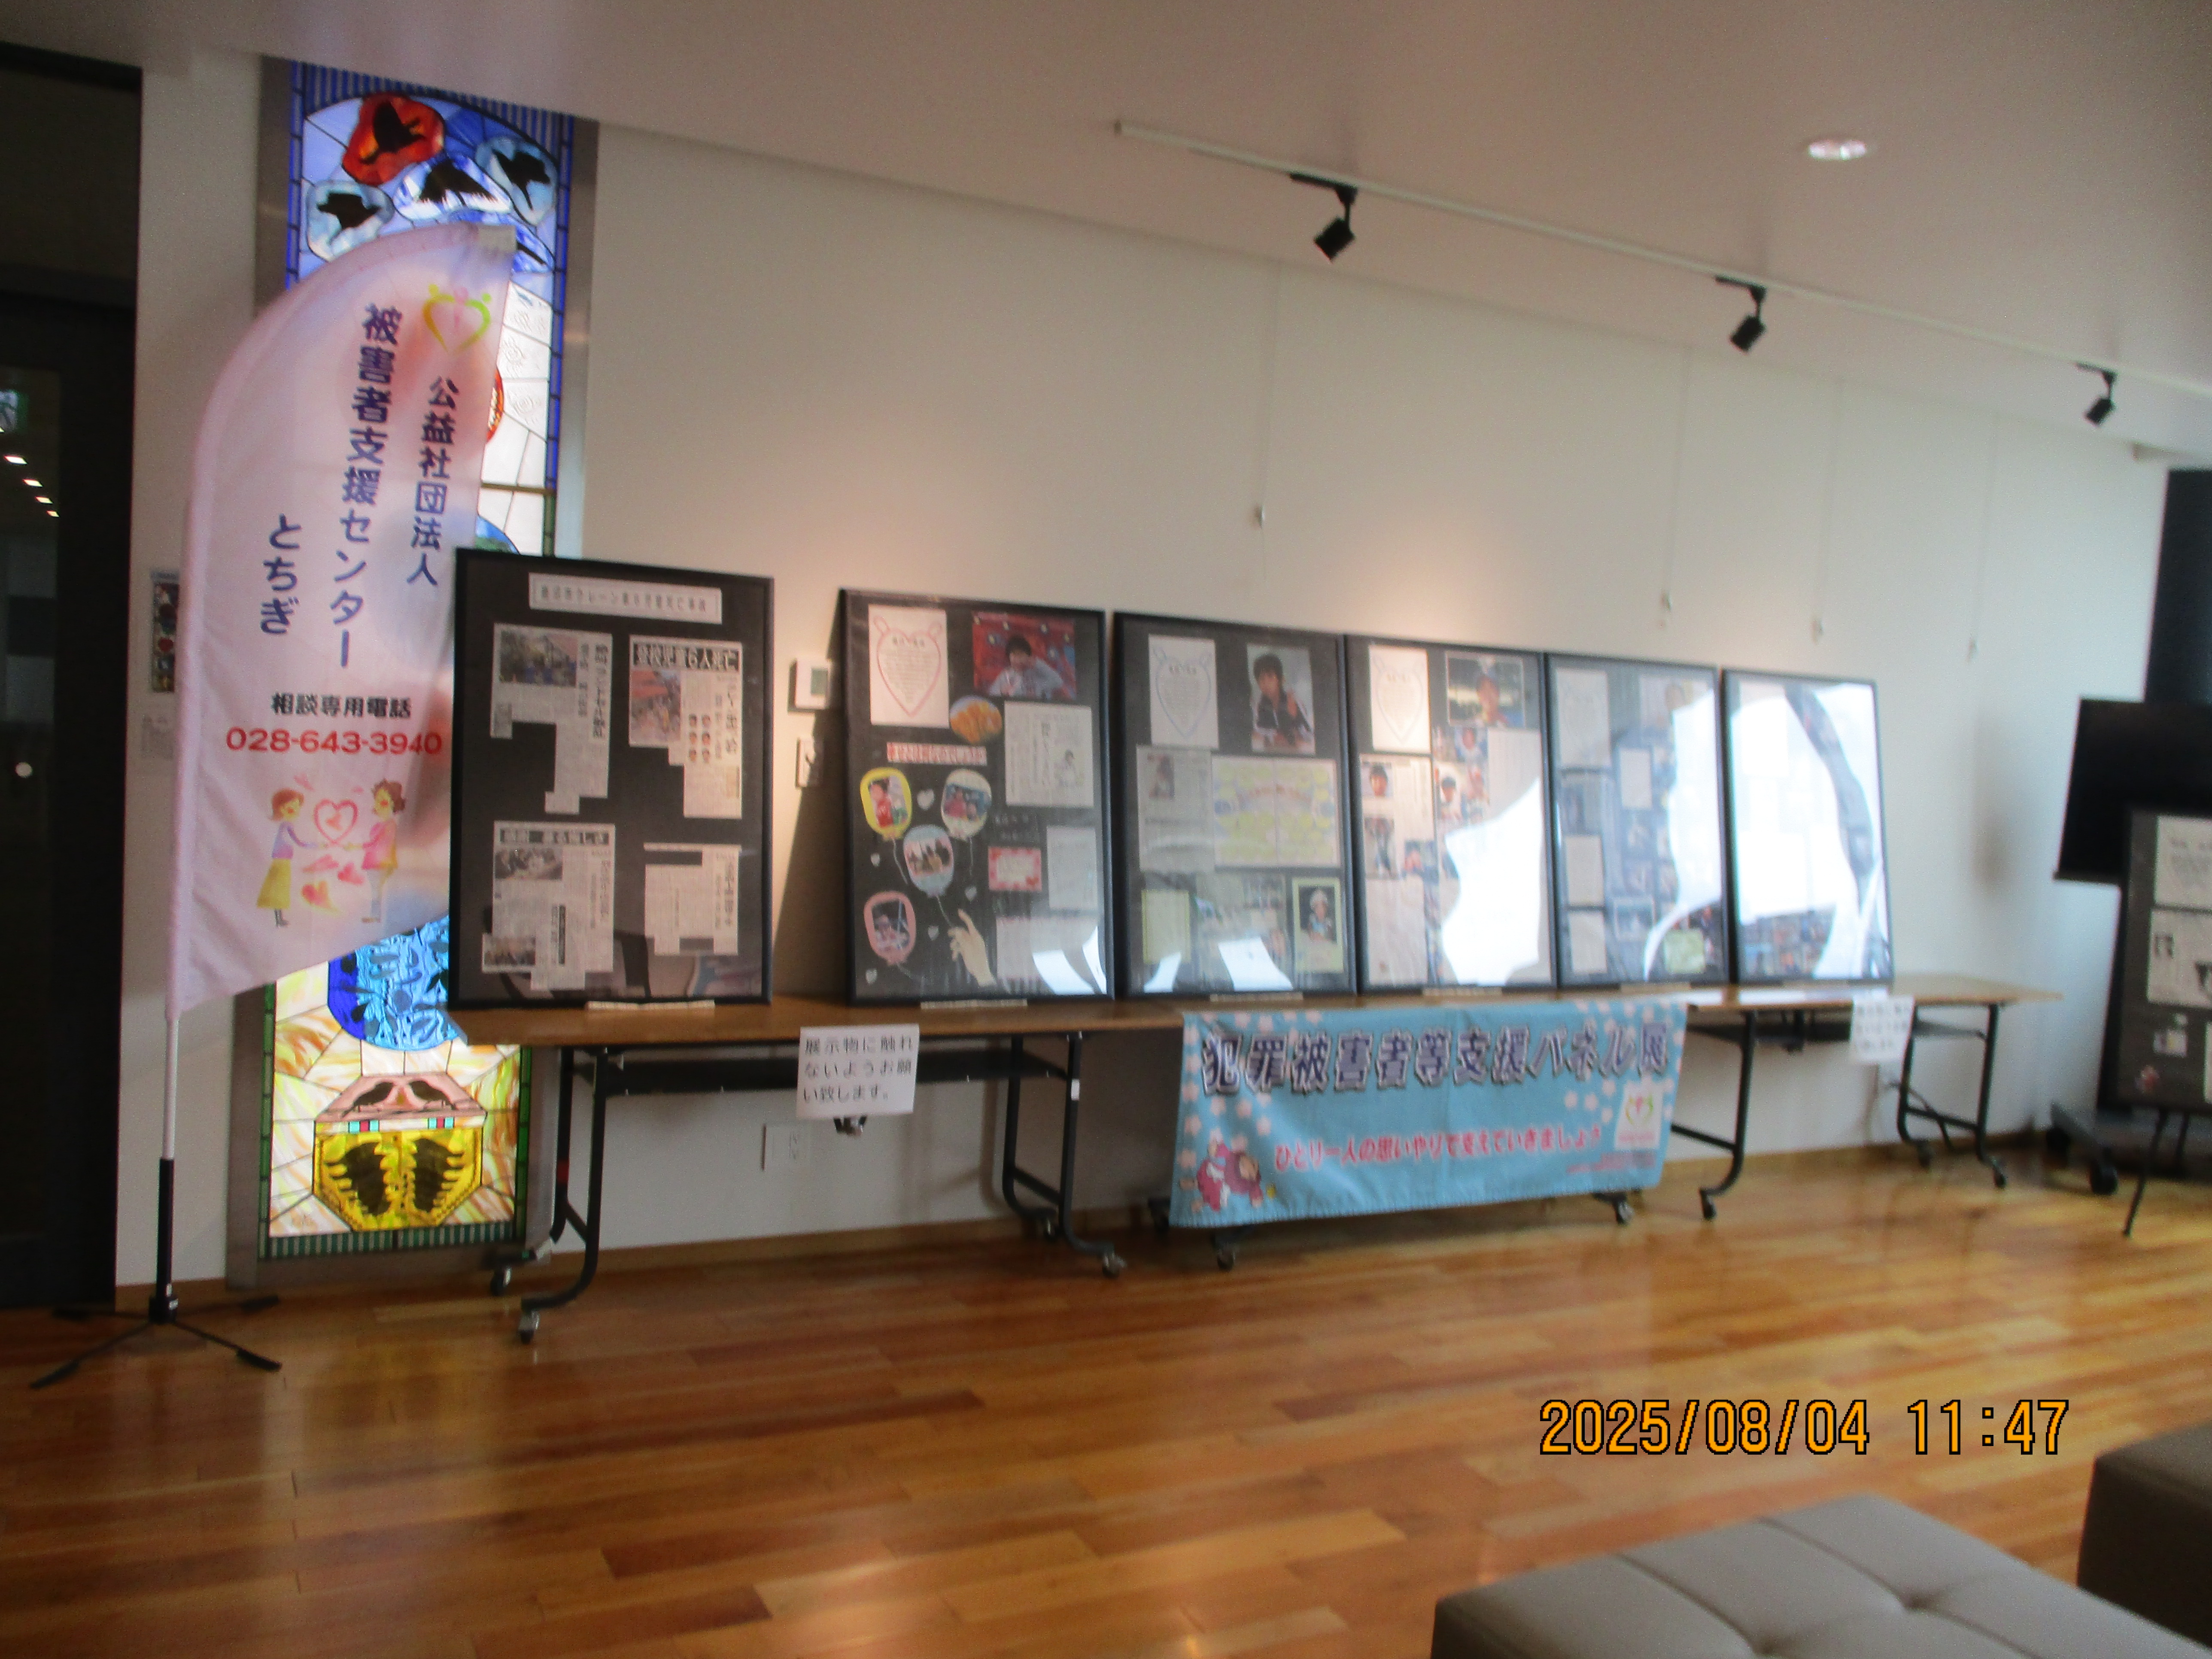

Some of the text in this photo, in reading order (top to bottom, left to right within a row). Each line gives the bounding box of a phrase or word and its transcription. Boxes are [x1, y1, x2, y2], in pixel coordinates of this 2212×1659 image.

[329, 303, 404, 669] 被害者支援センター
[407, 376, 458, 586] 公益社団法人
[259, 514, 302, 635] とちぎ
[226, 726, 443, 754] 028-643-3940
[271, 693, 411, 718] 相談専用電話
[1202, 1022, 1668, 1095] 犯罪被害者等支援パネル展
